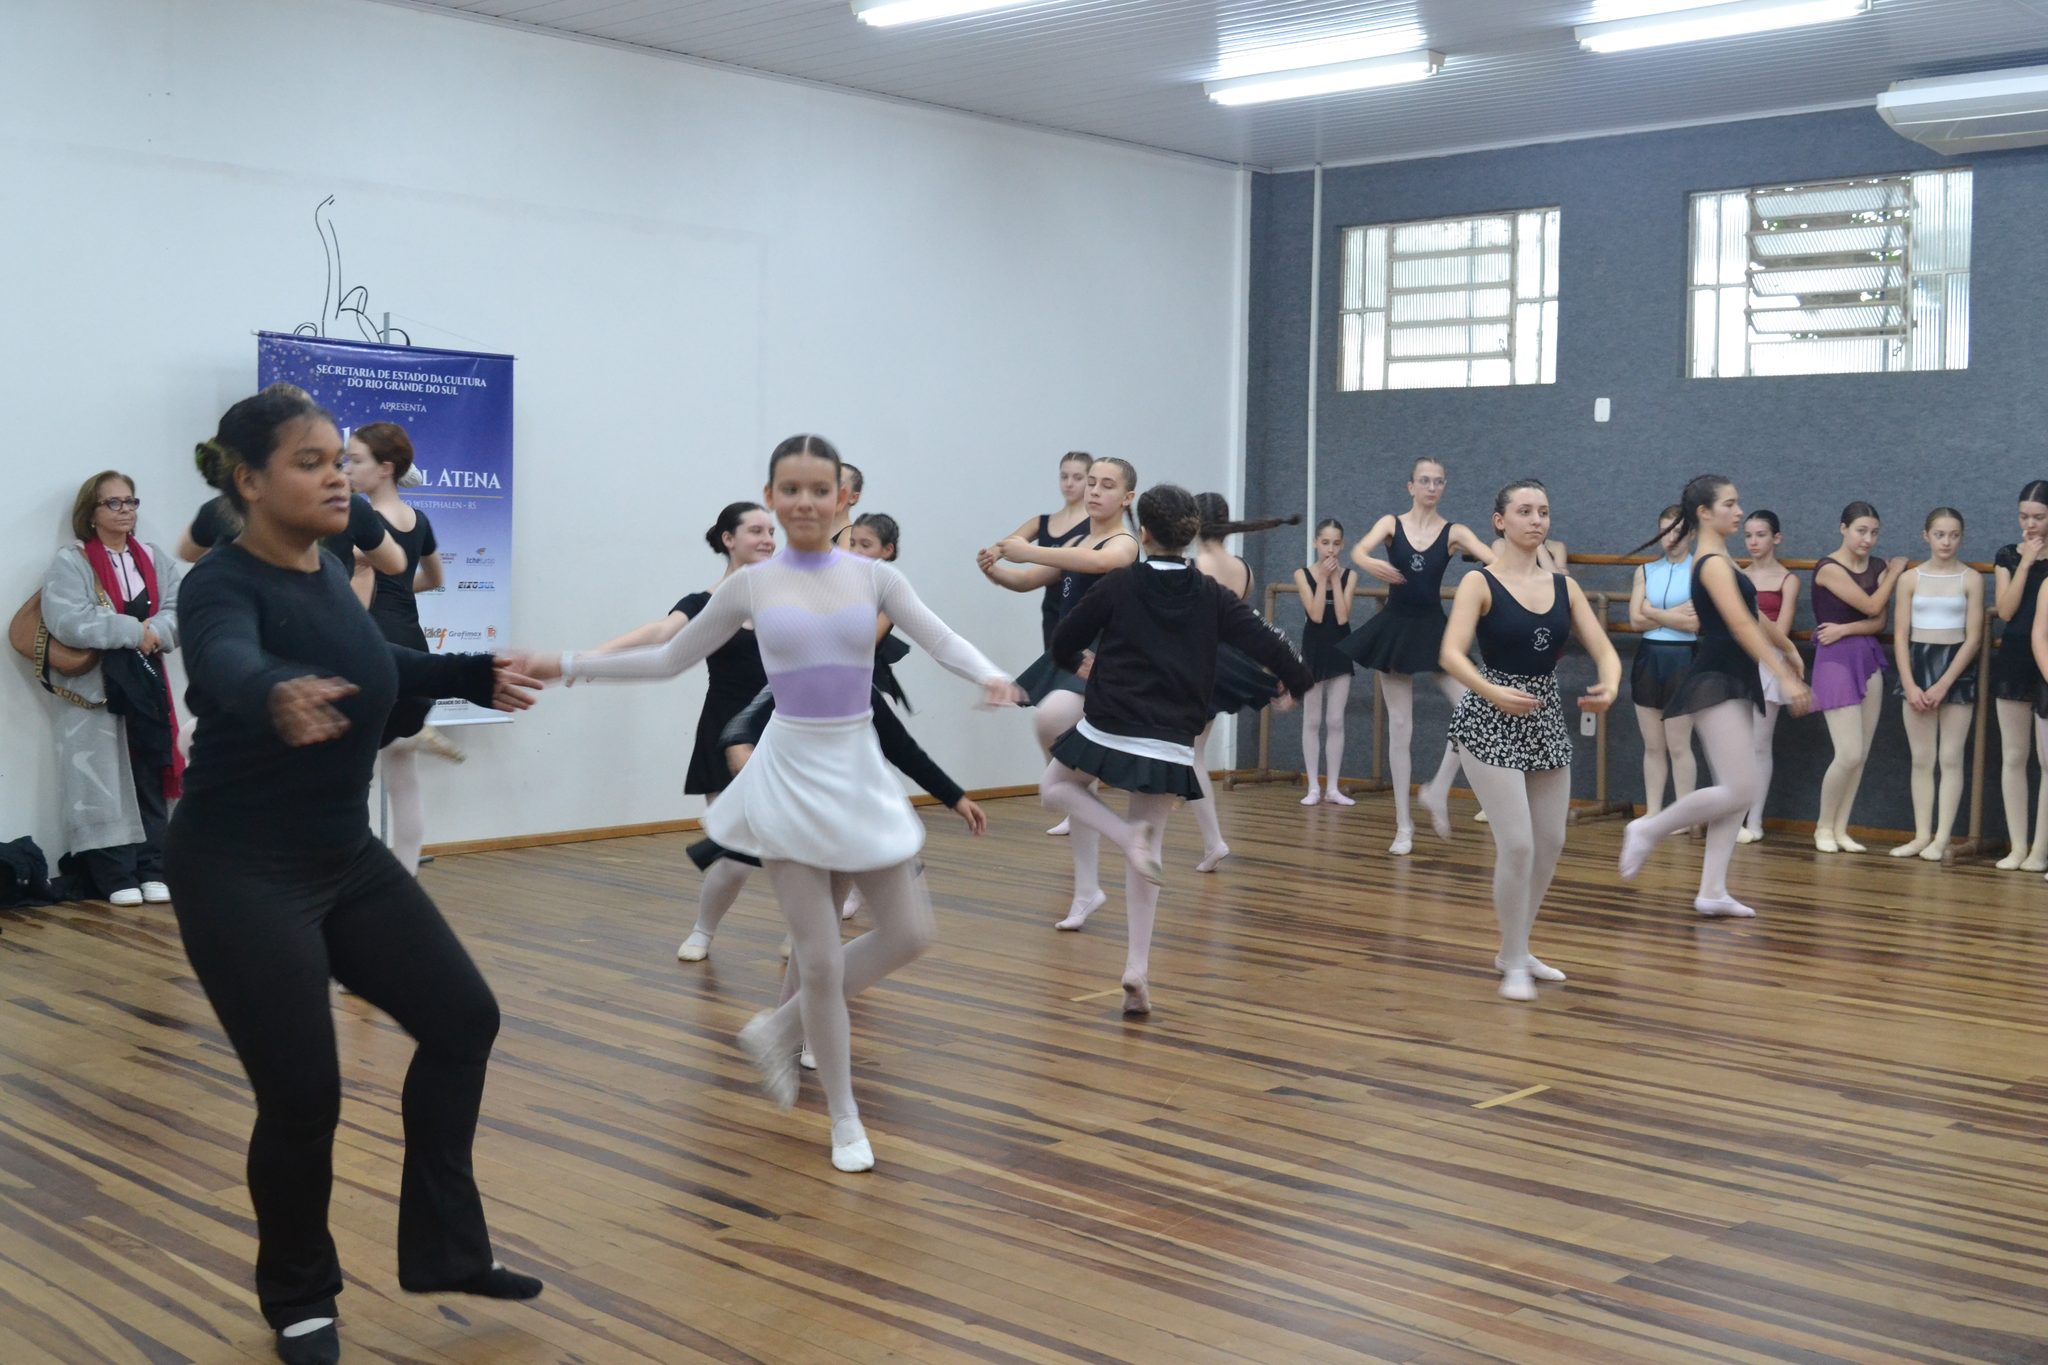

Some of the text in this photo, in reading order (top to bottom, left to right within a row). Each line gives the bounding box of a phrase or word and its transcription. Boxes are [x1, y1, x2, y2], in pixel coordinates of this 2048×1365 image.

[316, 364, 487, 388] SECRETARIA DE ESTADO DA CULTURA
[347, 377, 459, 396] DO RIO GRANDE DO SUL
[379, 401, 427, 413] APRESENTA
[437, 468, 502, 489] ATENA
[413, 499, 462, 509] WESTPHALEN
